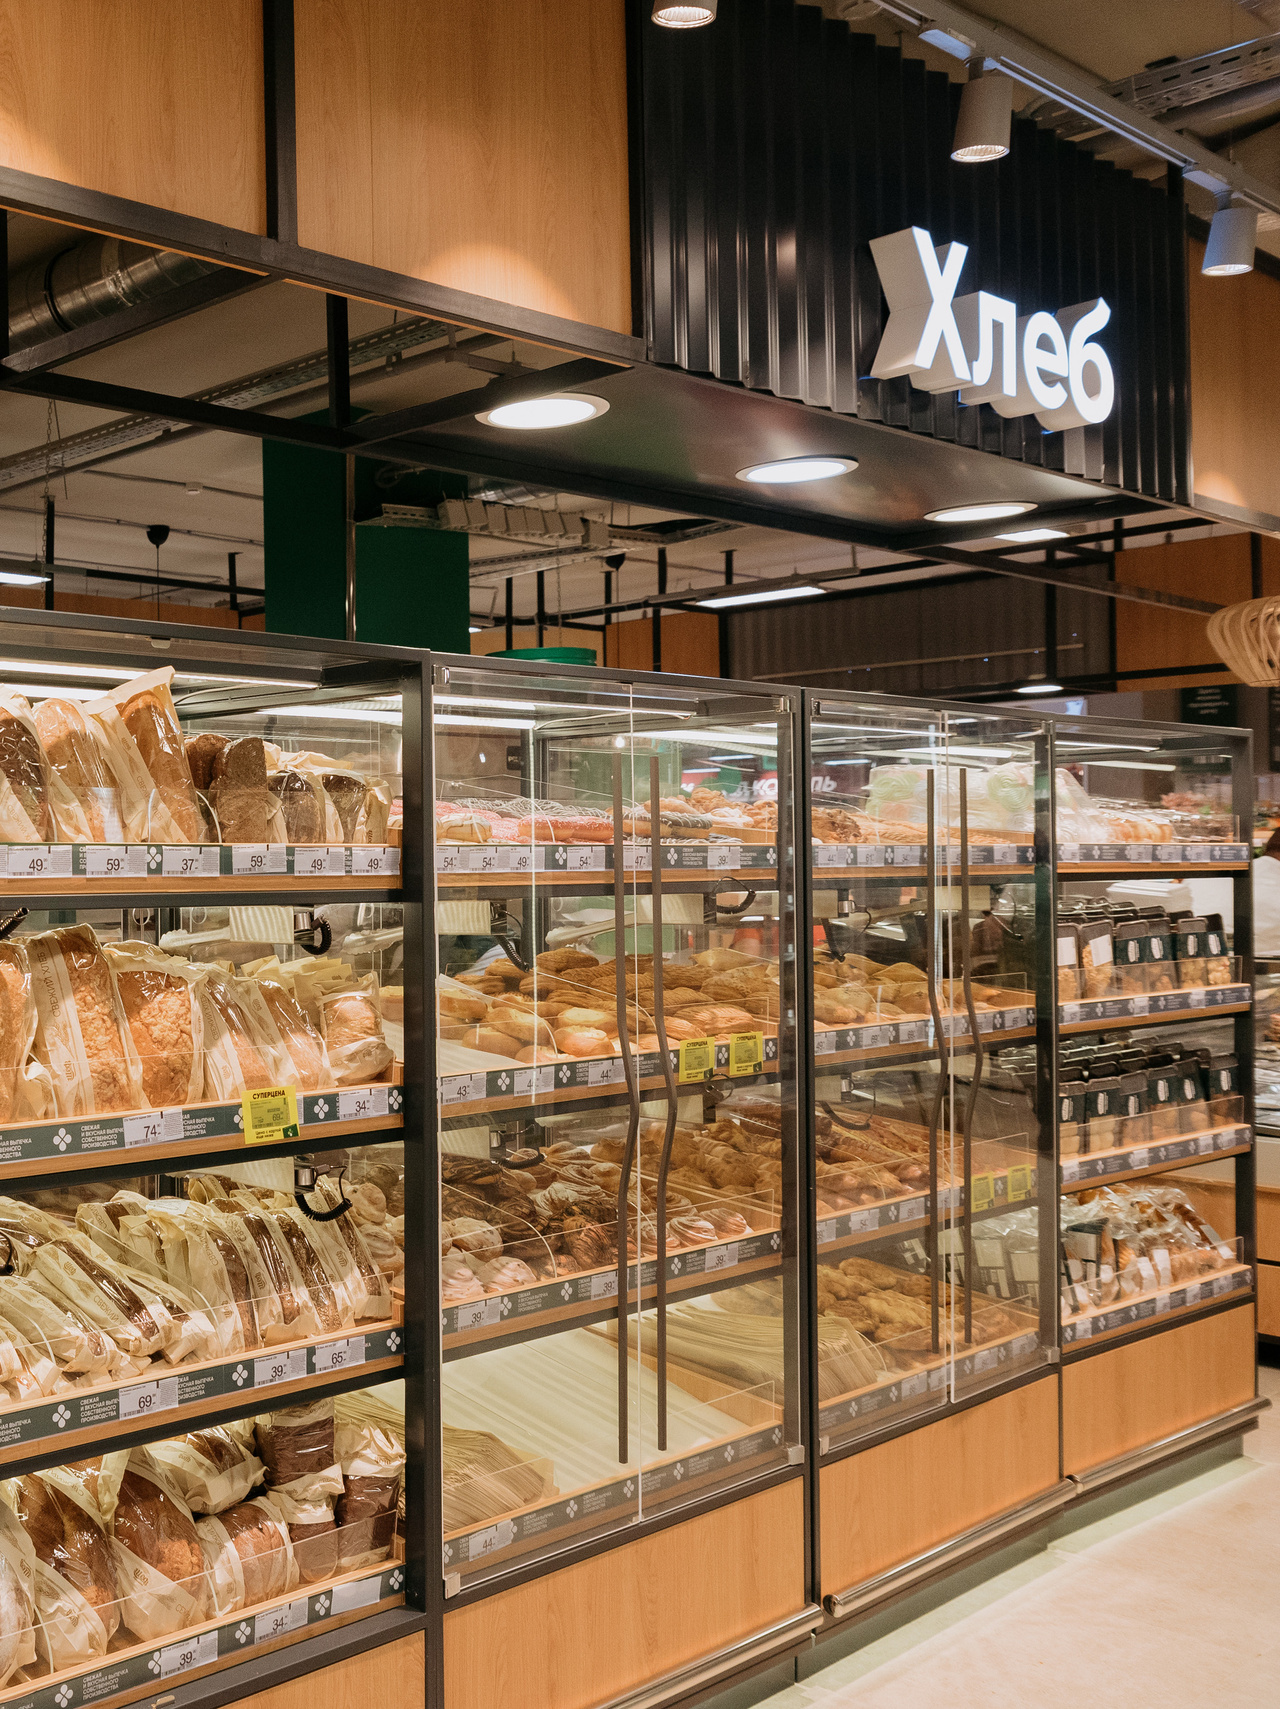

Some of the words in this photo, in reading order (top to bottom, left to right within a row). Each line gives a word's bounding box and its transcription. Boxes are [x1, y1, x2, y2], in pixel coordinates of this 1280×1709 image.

[908, 225, 1115, 426] Хлеб
[28, 858, 43, 871] 49
[106, 858, 120, 871] 59
[181, 859, 194, 871] 37
[250, 855, 263, 867] 59
[311, 858, 323, 870] 49
[368, 858, 379, 870] 49
[38, 952, 50, 974] ХЛЕБ
[44, 976, 61, 1018] СВЕЖИЙ
[252, 1090, 286, 1100] СУПЕРЦЕНА
[457, 1085, 467, 1097] 43
[355, 1100, 367, 1112] 34
[143, 1125, 157, 1138] 74
[10, 1137, 32, 1146] ВЫПЕЧКА
[471, 1311, 482, 1323] 39
[331, 1351, 343, 1365] 65
[271, 1365, 283, 1378] 39
[138, 1395, 152, 1409] 69
[272, 1616, 284, 1631] 34
[179, 1651, 193, 1666] 39
